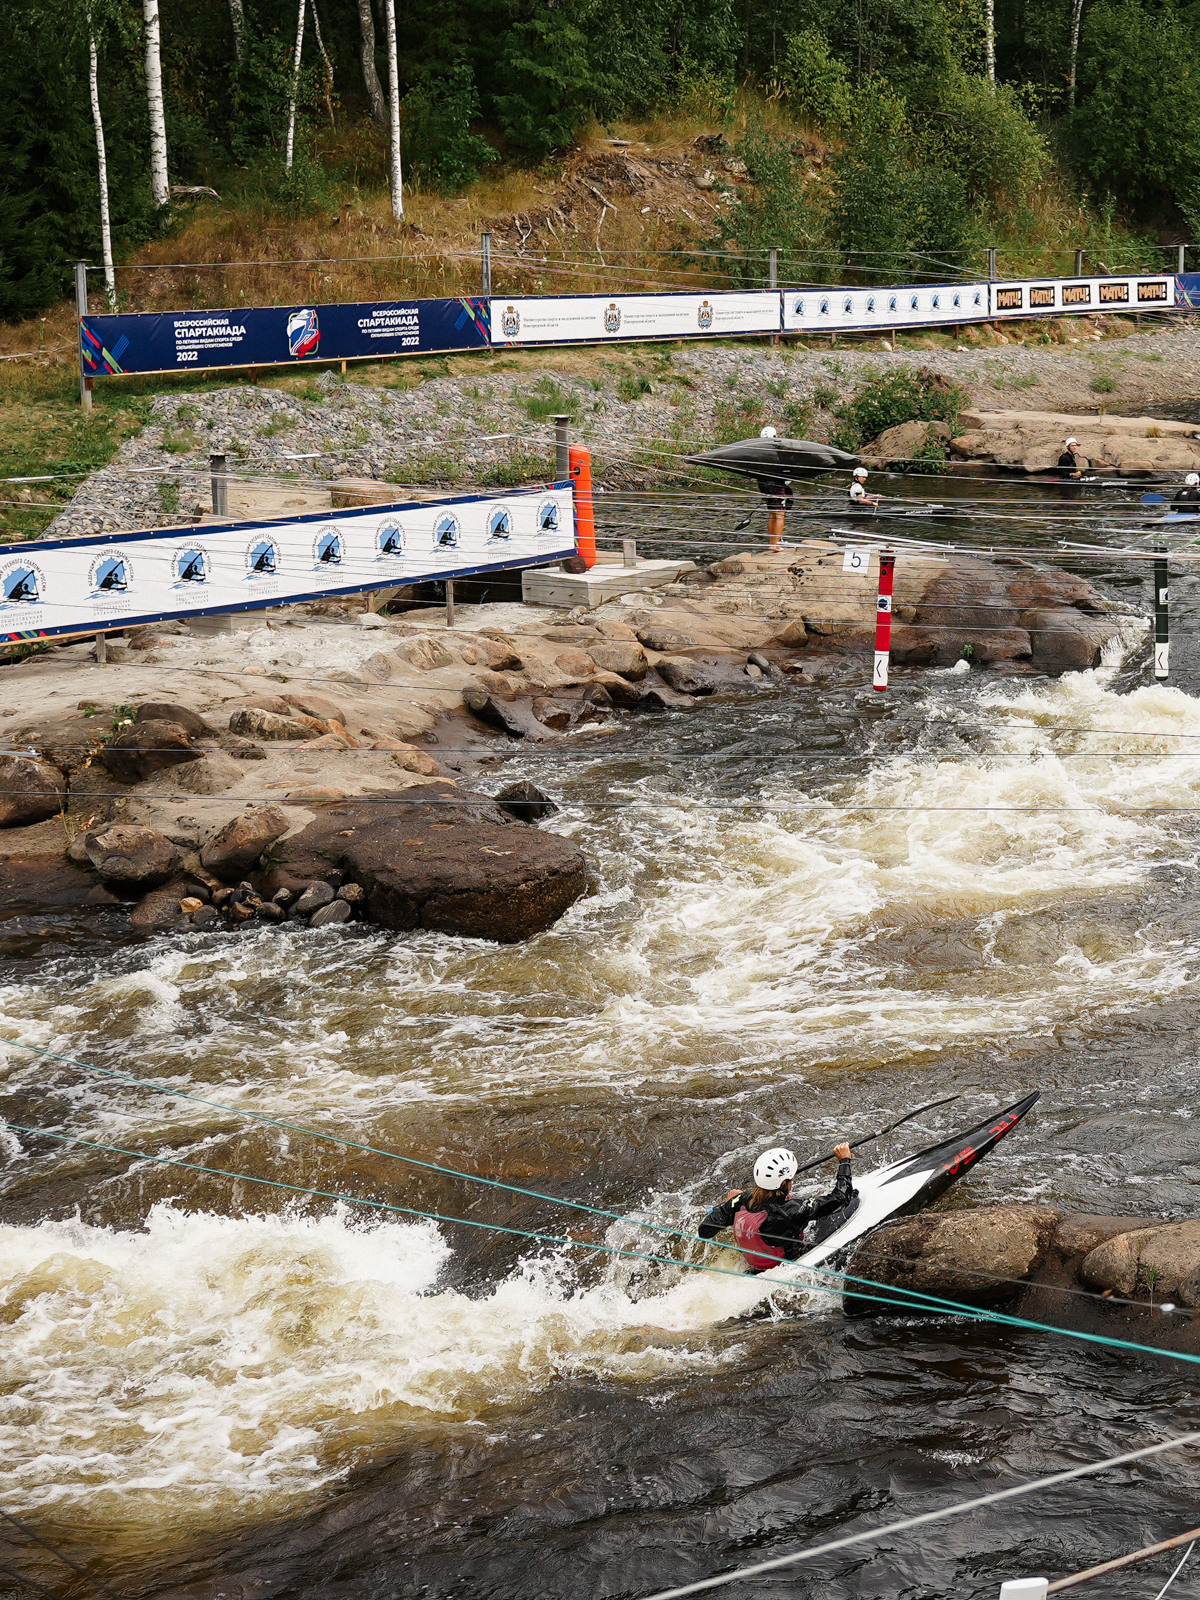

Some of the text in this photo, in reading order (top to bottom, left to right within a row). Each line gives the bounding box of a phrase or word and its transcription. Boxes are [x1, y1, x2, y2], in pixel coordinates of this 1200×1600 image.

[372, 308, 419, 317] ВСЕРОССИЙСКАЯ
[174, 318, 229, 328] ВСЕРОССИЙСКАЯ
[358, 316, 419, 328] СПАРТАКИАДА
[175, 326, 246, 338] СПАРТАКИАДА
[402, 337, 419, 346] 2022
[177, 351, 198, 361] 2022
[851, 552, 861, 568] 5
